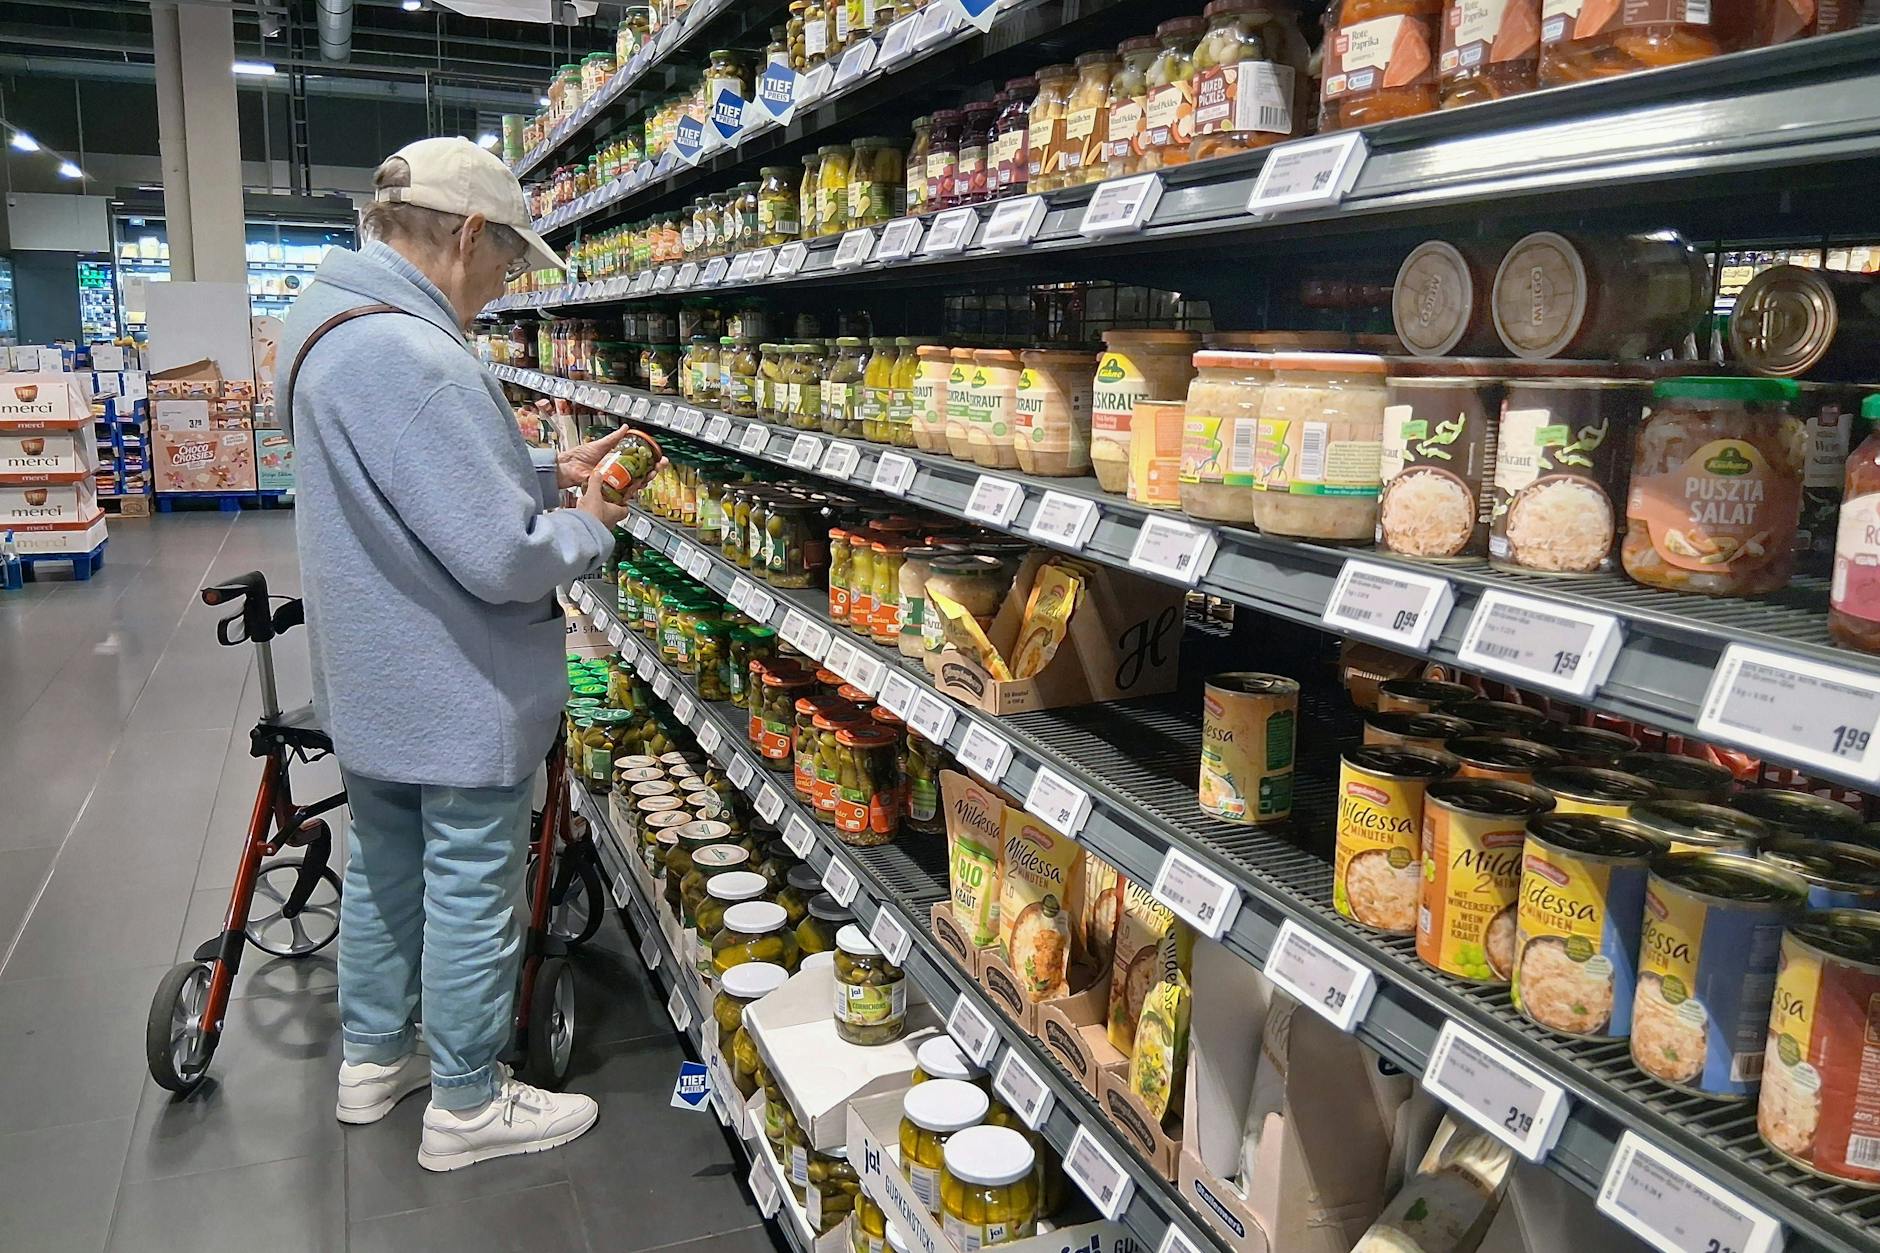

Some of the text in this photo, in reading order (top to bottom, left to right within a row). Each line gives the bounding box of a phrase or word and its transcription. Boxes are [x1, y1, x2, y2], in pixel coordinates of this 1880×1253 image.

[1352, 29, 1369, 41] Rote
[1351, 36, 1379, 51] Paprika
[766, 77, 793, 93] TIEF
[1200, 78, 1223, 95] MIXED
[767, 91, 788, 102] PREIS
[1199, 88, 1226, 107] PICKLES
[718, 103, 741, 119] TIEF
[717, 115, 738, 127] PREIS
[679, 127, 700, 141] TIEF
[2, 402, 53, 414] merci
[17, 421, 45, 429] merci
[178, 444, 209, 455] CHOCO
[8, 455, 59, 467] merci
[1685, 477, 1764, 501] PUSZTA
[11, 505, 62, 517] merci
[1688, 501, 1757, 524] SALAT
[16, 536, 67, 548] merci
[1393, 610, 1419, 631] 0.99
[1553, 650, 1580, 675] 1.59
[1832, 725, 1871, 755] 1.99
[1341, 818, 1395, 843] 2 MINUTEN
[1005, 836, 1062, 884] Mildessa
[959, 859, 983, 887] BIO
[1007, 860, 1048, 889] 2 MINUTEN
[1474, 873, 1492, 893] 2
[954, 887, 977, 909] KRAUT
[1454, 890, 1468, 899] MIT
[1124, 898, 1139, 918] 2
[1448, 897, 1500, 913] WINZERSEKT
[1460, 911, 1483, 923] WEIN
[1527, 905, 1573, 932] MINUTEN
[1451, 920, 1480, 933] SAUER
[1450, 930, 1480, 943] KRAUT
[852, 1001, 887, 1010] CORNICHONS
[1323, 986, 1347, 1009] 2.19
[681, 1074, 705, 1086] TIEF
[682, 1085, 705, 1094] PREIS
[1504, 1106, 1533, 1133] 2.19
[1854, 1110, 1870, 1122] 400
[864, 1137, 881, 1176] ja!
[989, 1227, 1003, 1240] ja!
